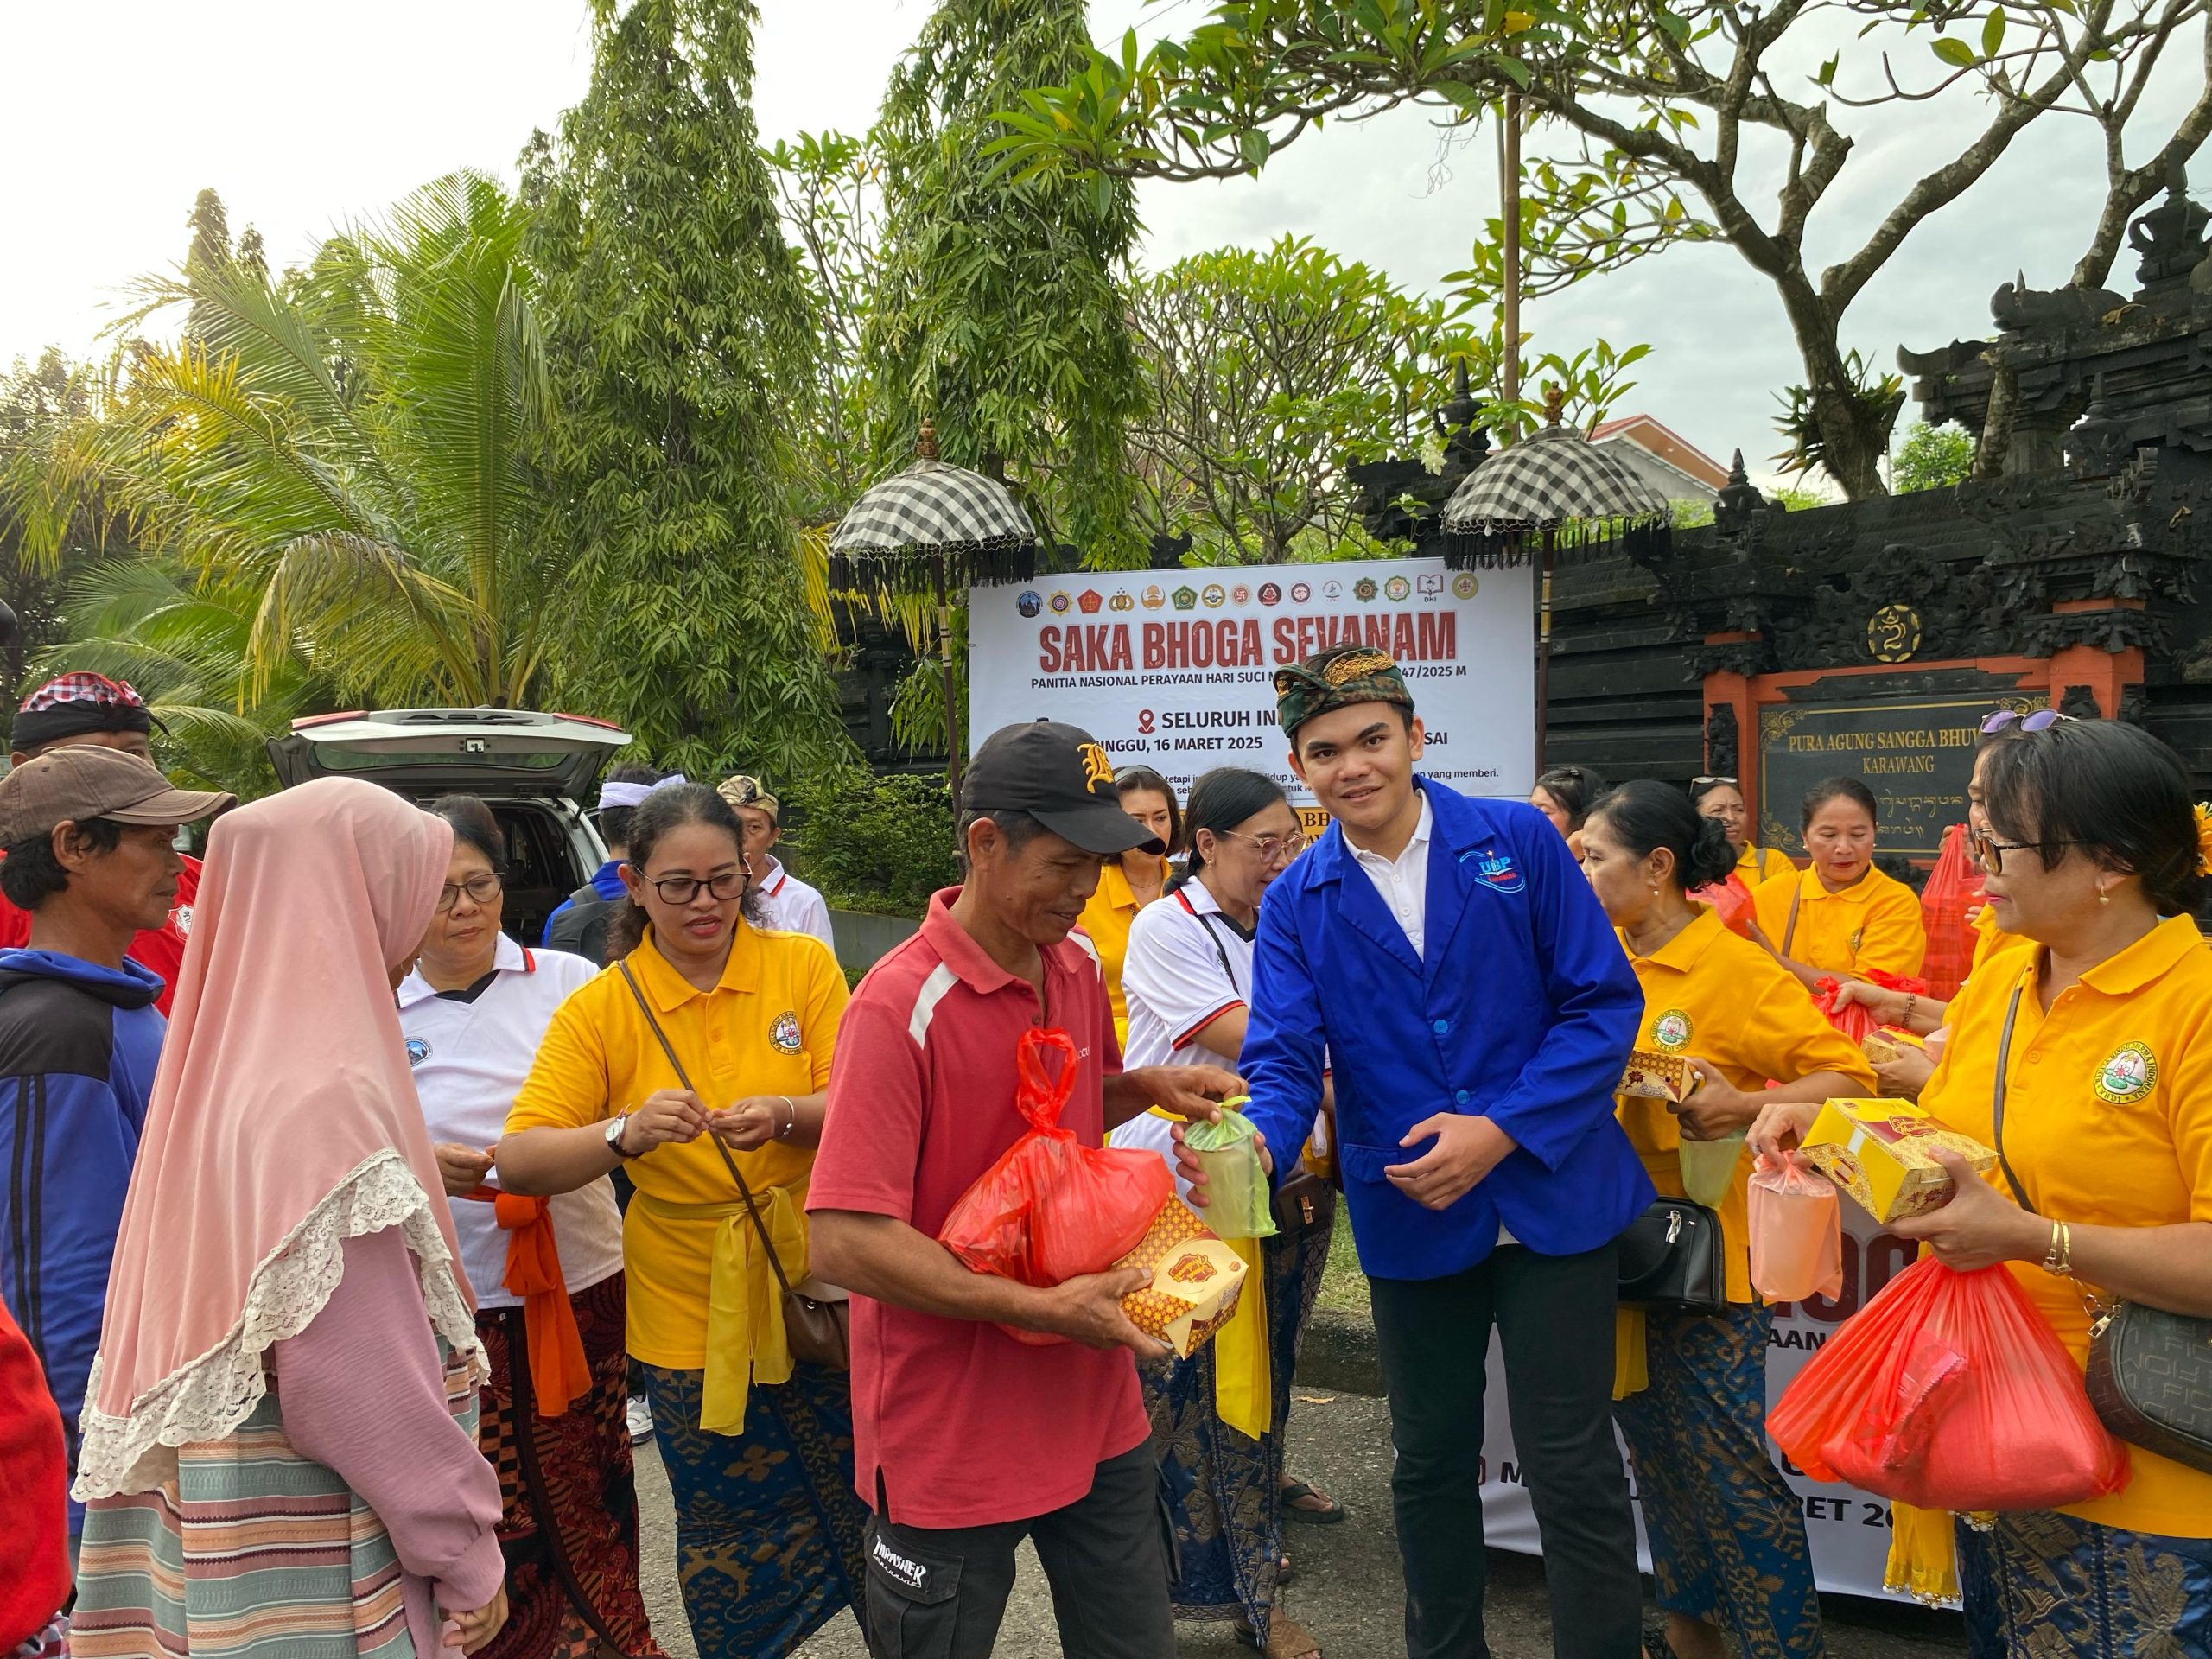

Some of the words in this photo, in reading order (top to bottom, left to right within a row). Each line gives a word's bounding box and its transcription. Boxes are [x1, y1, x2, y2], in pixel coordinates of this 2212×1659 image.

[1039, 623, 1134, 673] SAKA
[1143, 619, 1263, 671] BHOGA
[1273, 612, 1456, 665] SEVANAM
[1456, 665, 1467, 676] M
[1031, 677, 1077, 689] PANITIA
[1079, 676, 1138, 687] NASIONAL
[1141, 673, 1203, 685] PERAYAAN
[1206, 672, 1234, 683] HARI
[1237, 671, 1265, 683] SUCI
[1161, 710, 1250, 728] SELURUH
[1154, 738, 1171, 751] 16
[1174, 737, 1224, 750] MARET
[1227, 736, 1262, 749] 2025
[1789, 734, 1824, 753] PURA
[1827, 733, 1874, 750] AGUNG
[1877, 730, 1936, 749] SANGGA
[1863, 755, 1935, 774] KARAWANG
[1427, 771, 1452, 780] yang
[1454, 768, 1499, 778] memberi.
[1479, 856, 1510, 874] UBP
